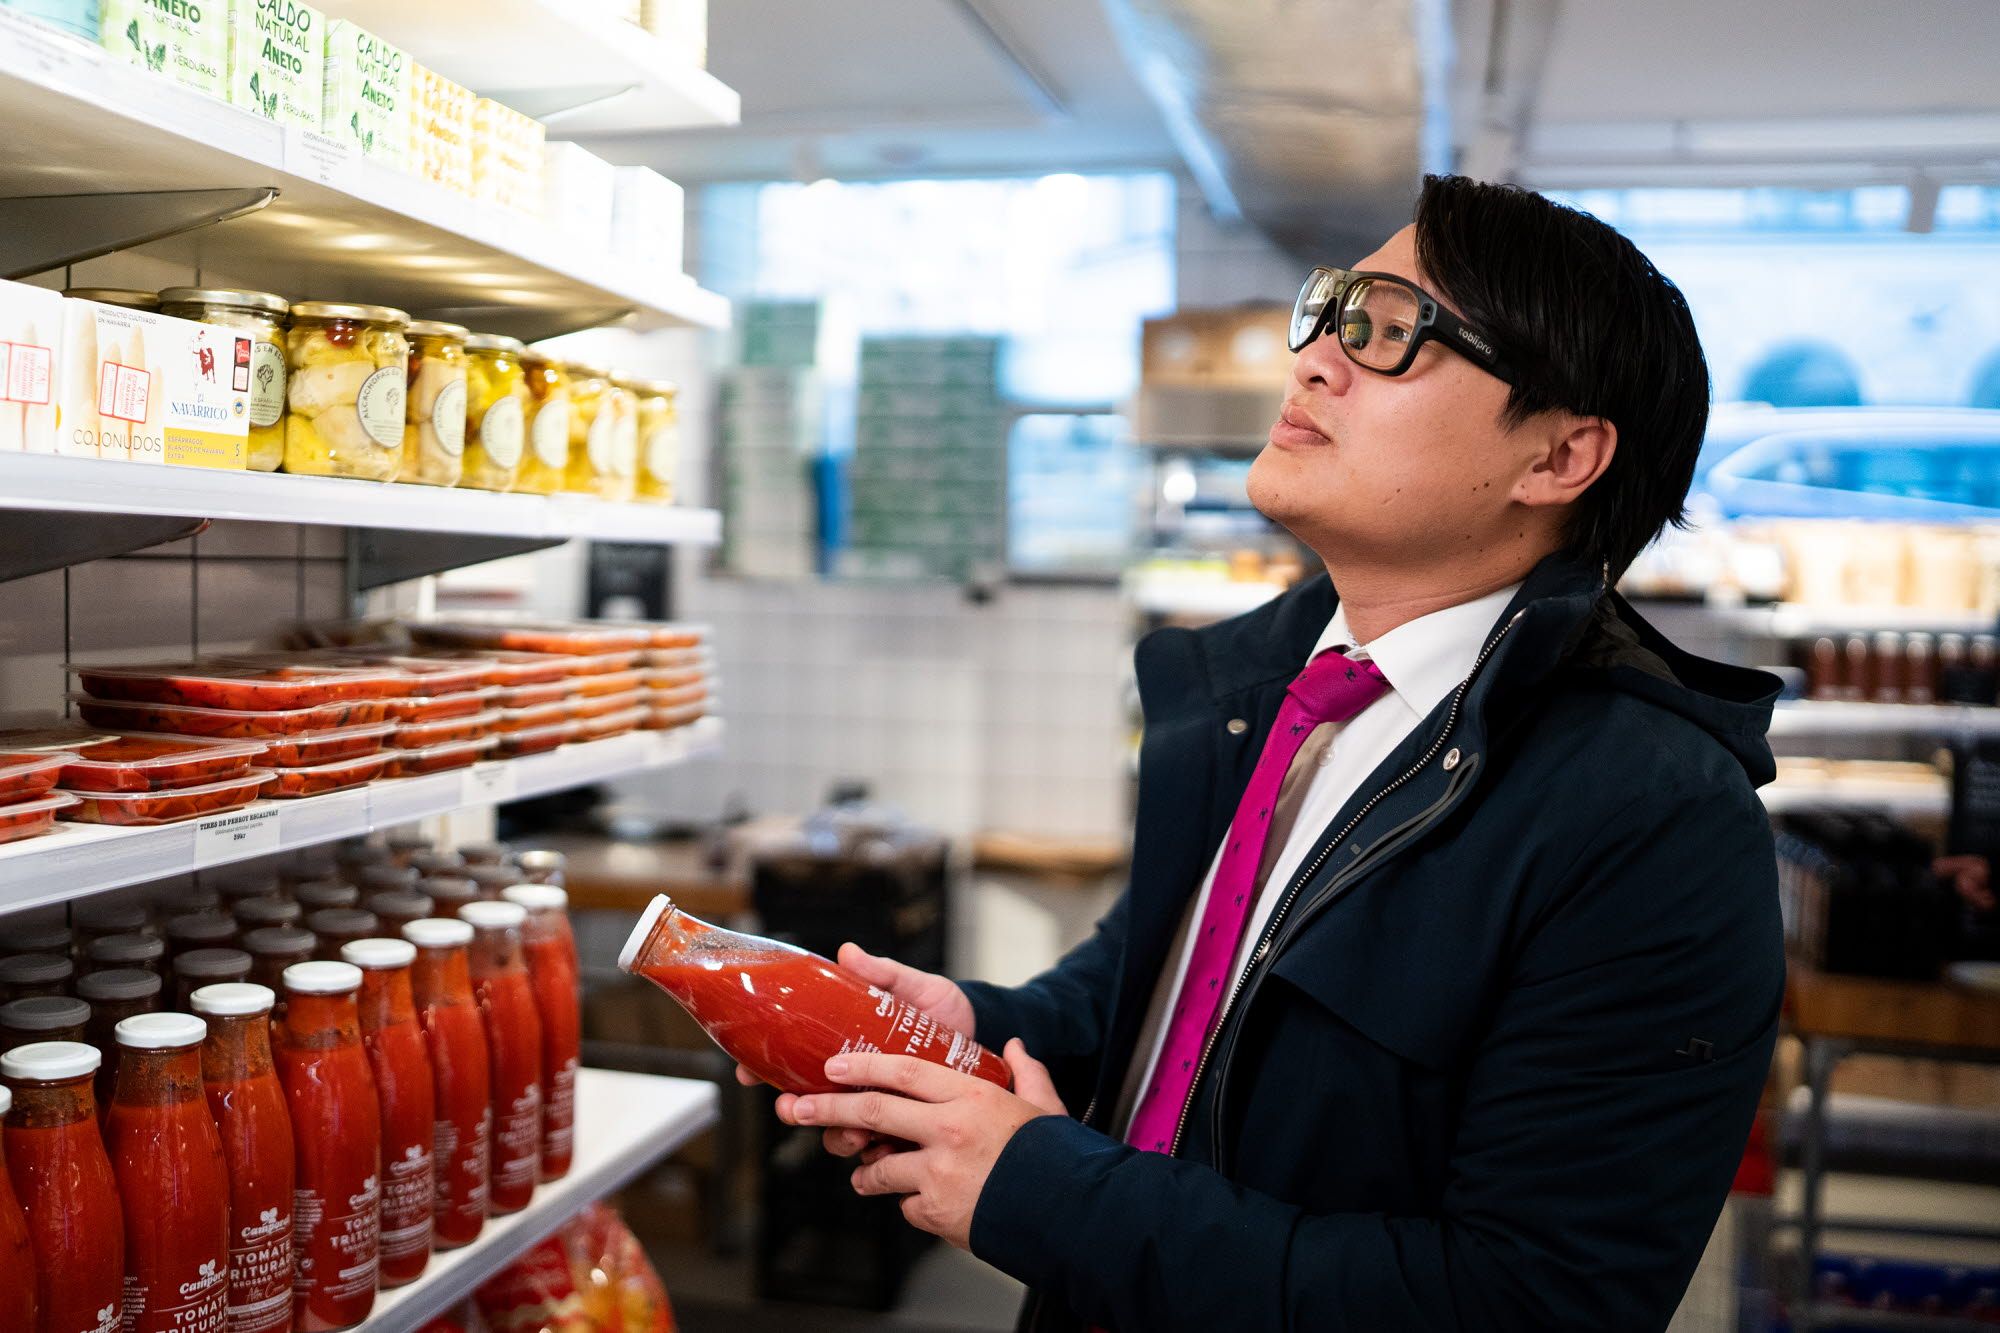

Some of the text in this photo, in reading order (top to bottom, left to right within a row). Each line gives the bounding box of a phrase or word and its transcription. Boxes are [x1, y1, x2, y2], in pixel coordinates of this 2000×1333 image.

[144, 0, 201, 24] NETO
[256, 11, 310, 53] NATURAL
[261, 37, 303, 74] ANETO
[357, 33, 402, 73] CALDO
[356, 54, 401, 93] NATURAL
[361, 78, 395, 112] ANETO
[171, 401, 228, 420] NAVARRICO
[73, 429, 161, 453] COJONUDOS
[235, 443, 241, 457] 5
[200, 822, 218, 831] TIRES
[876, 990, 894, 1017] Camp
[898, 1004, 917, 1033] TOMA
[905, 1012, 929, 1054] TRITUR
[330, 1224, 378, 1249] TRITUR
[235, 1239, 291, 1265] TOMATE
